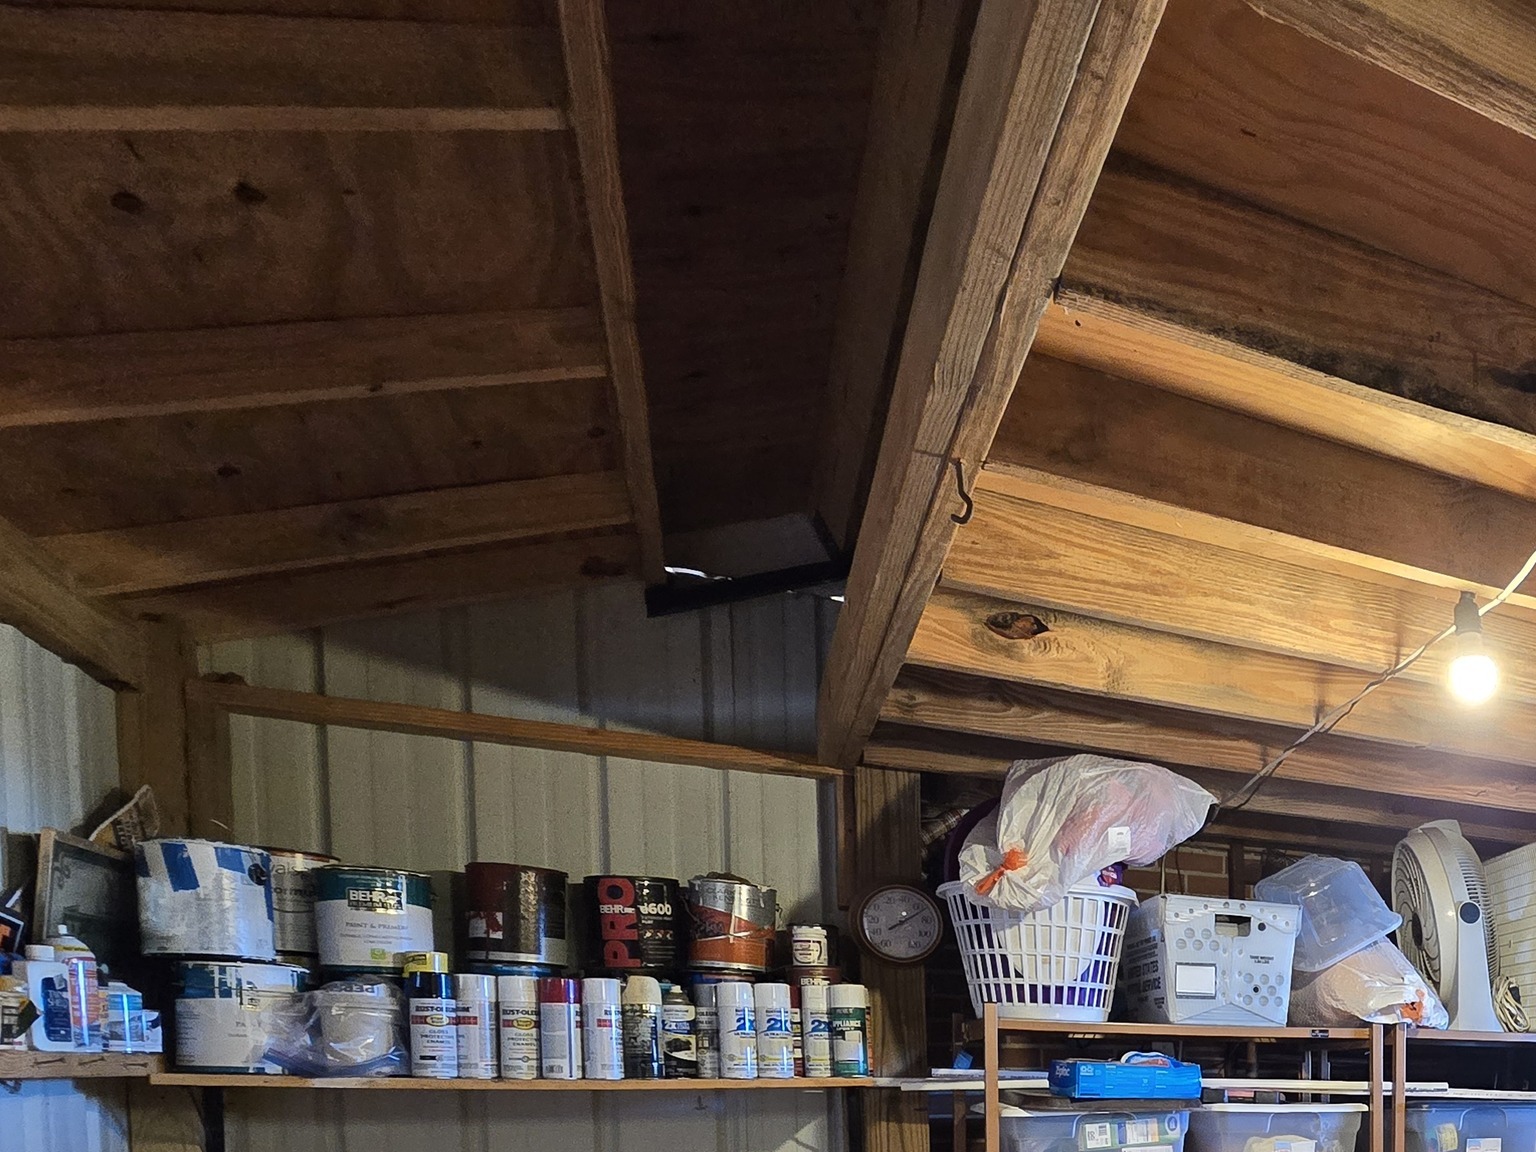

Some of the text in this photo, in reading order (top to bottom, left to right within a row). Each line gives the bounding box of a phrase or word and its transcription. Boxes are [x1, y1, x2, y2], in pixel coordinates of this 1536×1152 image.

[350, 889, 385, 901] BEHR
[600, 904, 624, 914] BEHR
[800, 978, 823, 986] BEHR
